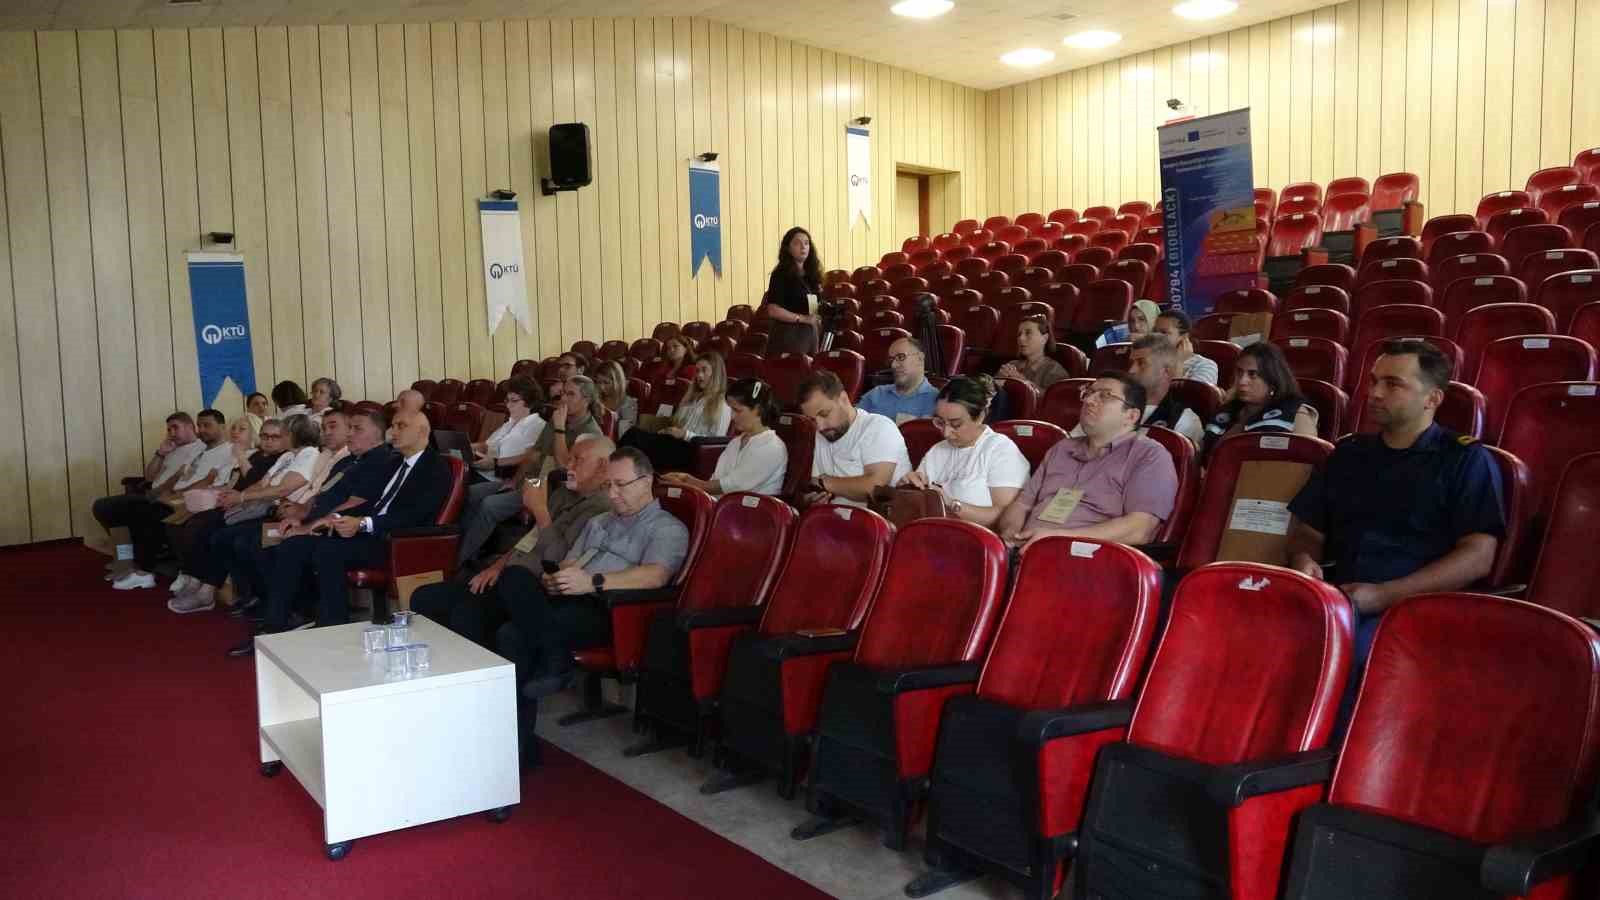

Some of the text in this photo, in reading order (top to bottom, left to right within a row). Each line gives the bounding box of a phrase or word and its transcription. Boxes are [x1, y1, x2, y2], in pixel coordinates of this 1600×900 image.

[1166, 187, 1179, 268] (BIOBLACK)
[503, 264, 519, 273] KTÜ
[222, 324, 245, 337] KTÜ
